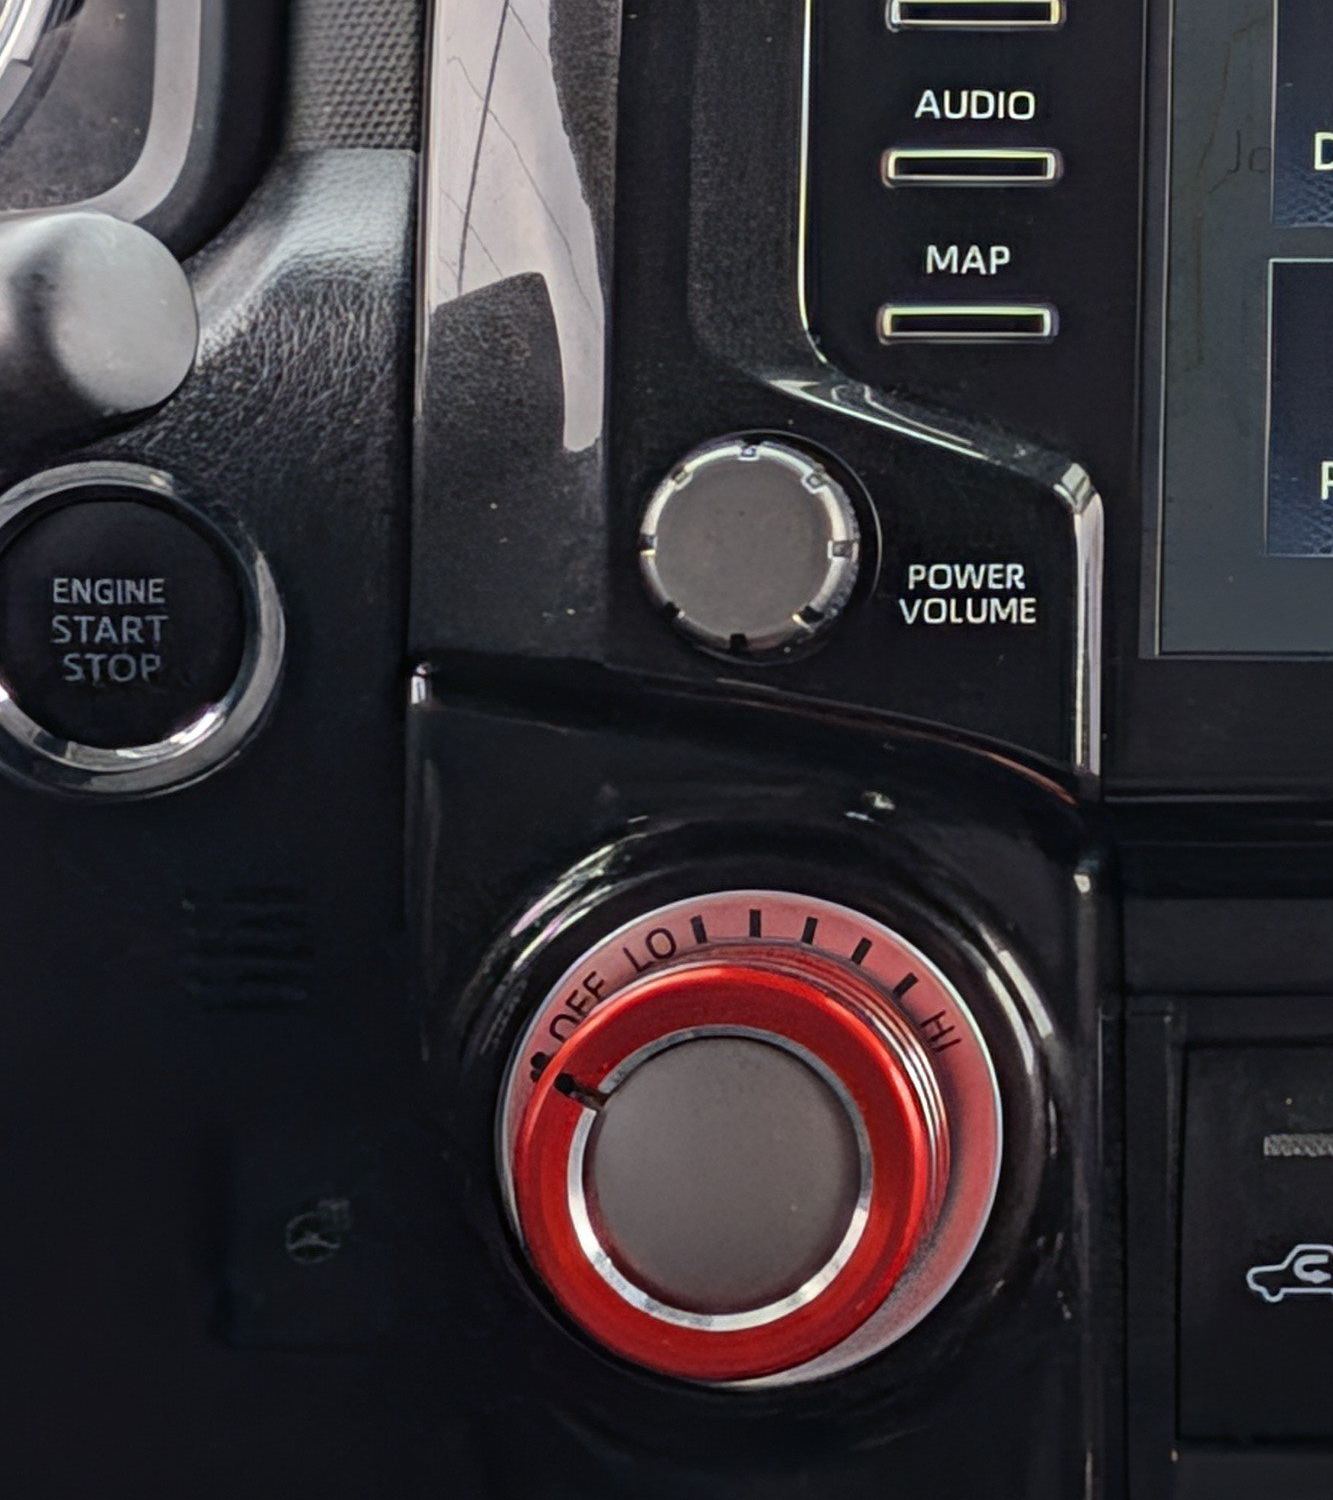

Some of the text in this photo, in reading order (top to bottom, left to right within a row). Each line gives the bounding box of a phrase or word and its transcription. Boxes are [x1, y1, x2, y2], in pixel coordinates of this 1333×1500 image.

[914, 89, 1035, 120] AUDIO
[926, 244, 1010, 275] MAP
[52, 578, 166, 605] ENGINE
[908, 563, 1026, 590] POWER
[898, 597, 1037, 625] VOLUME
[51, 615, 170, 644] START
[63, 654, 162, 683] STOP
[622, 927, 677, 973] LO
[549, 970, 605, 1043] OFF
[920, 1009, 963, 1053] HI
